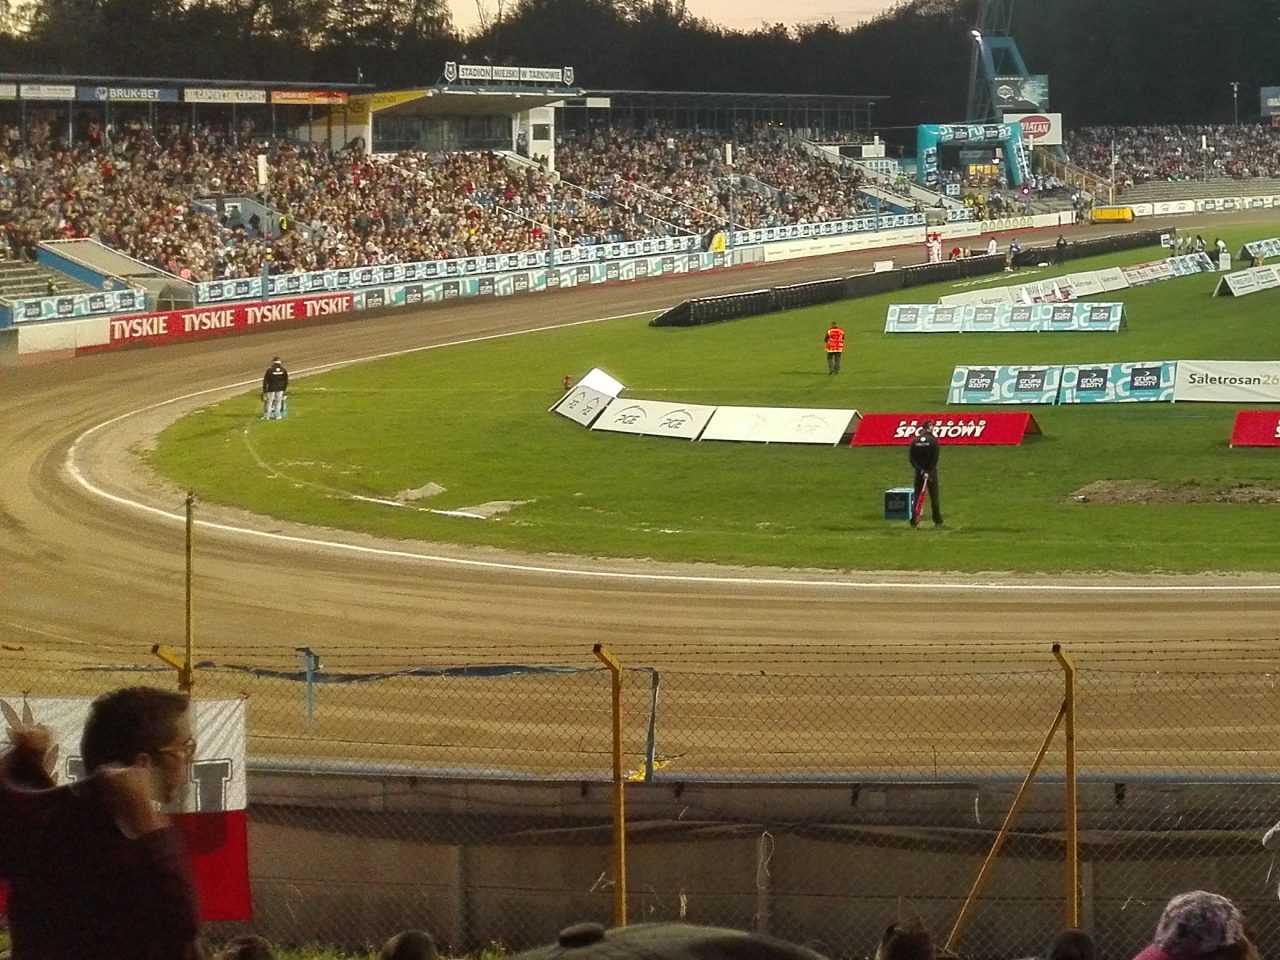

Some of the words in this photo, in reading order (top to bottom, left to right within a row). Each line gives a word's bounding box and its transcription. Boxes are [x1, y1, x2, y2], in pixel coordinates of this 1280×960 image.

[461, 68, 491, 77] STADION
[494, 70, 519, 79] MIEJSKI
[529, 71, 561, 80] TARNOWIE
[110, 89, 160, 99] BRUK-BET
[304, 296, 350, 318] TYSKIE
[245, 302, 295, 325] TYSKIE
[182, 309, 235, 332] TYSKIE
[111, 316, 168, 340] TYSKIE
[1188, 373, 1261, 385] Saletrosan
[614, 414, 640, 425] PGE
[660, 418, 686, 429] PGE
